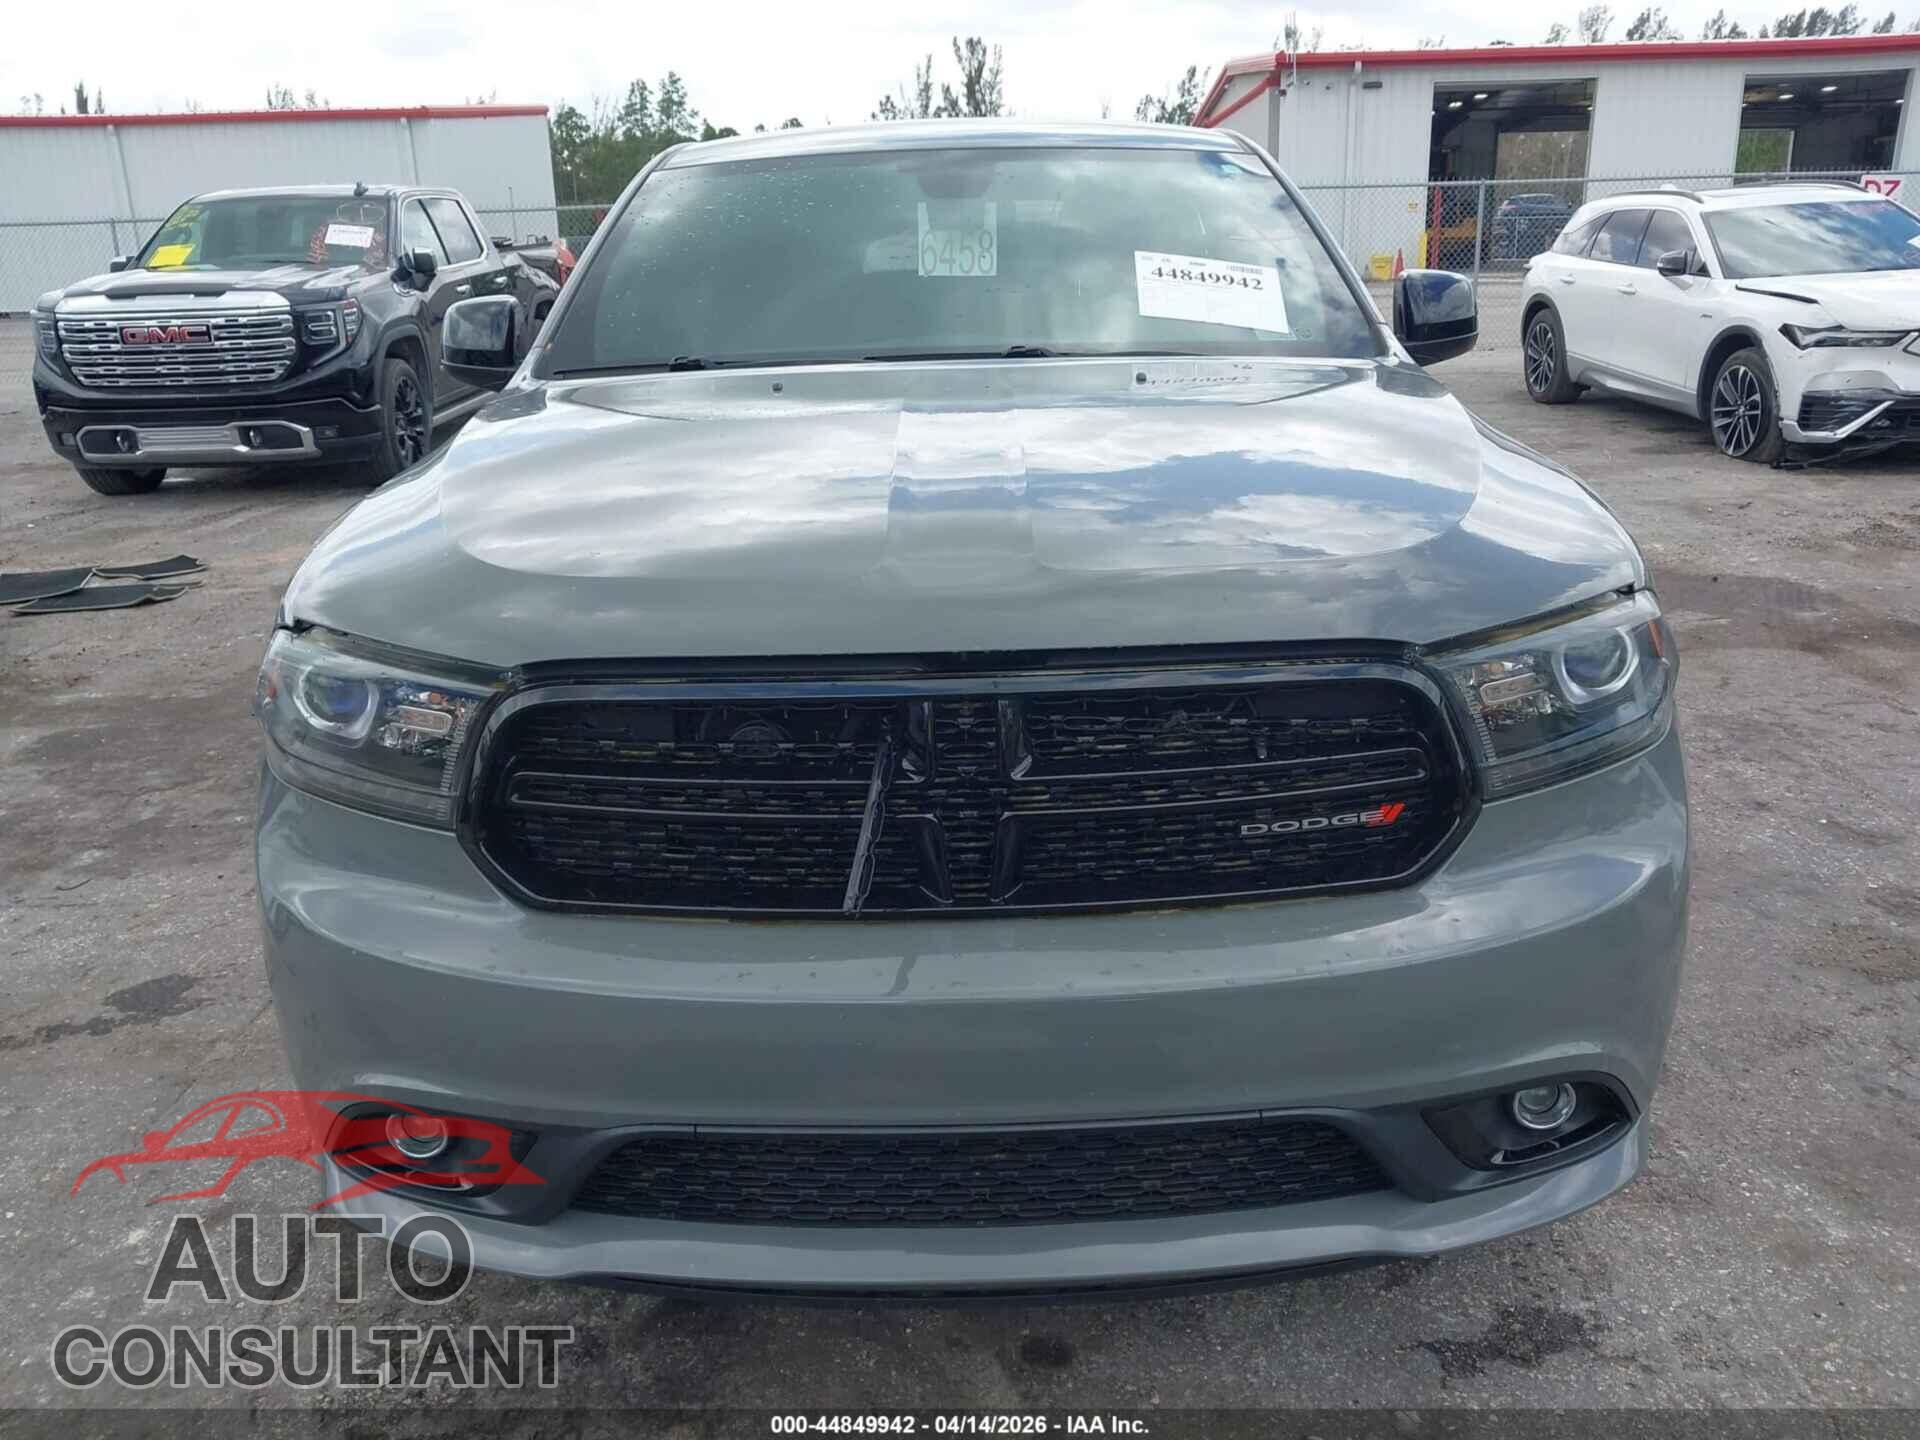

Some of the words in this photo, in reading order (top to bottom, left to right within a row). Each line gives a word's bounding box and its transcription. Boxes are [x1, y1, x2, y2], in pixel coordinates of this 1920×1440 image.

[921, 229, 993, 274] 6458
[1151, 266, 1264, 291] 44849942
[122, 325, 210, 346] GMC
[1240, 809, 1385, 835] DODGE
